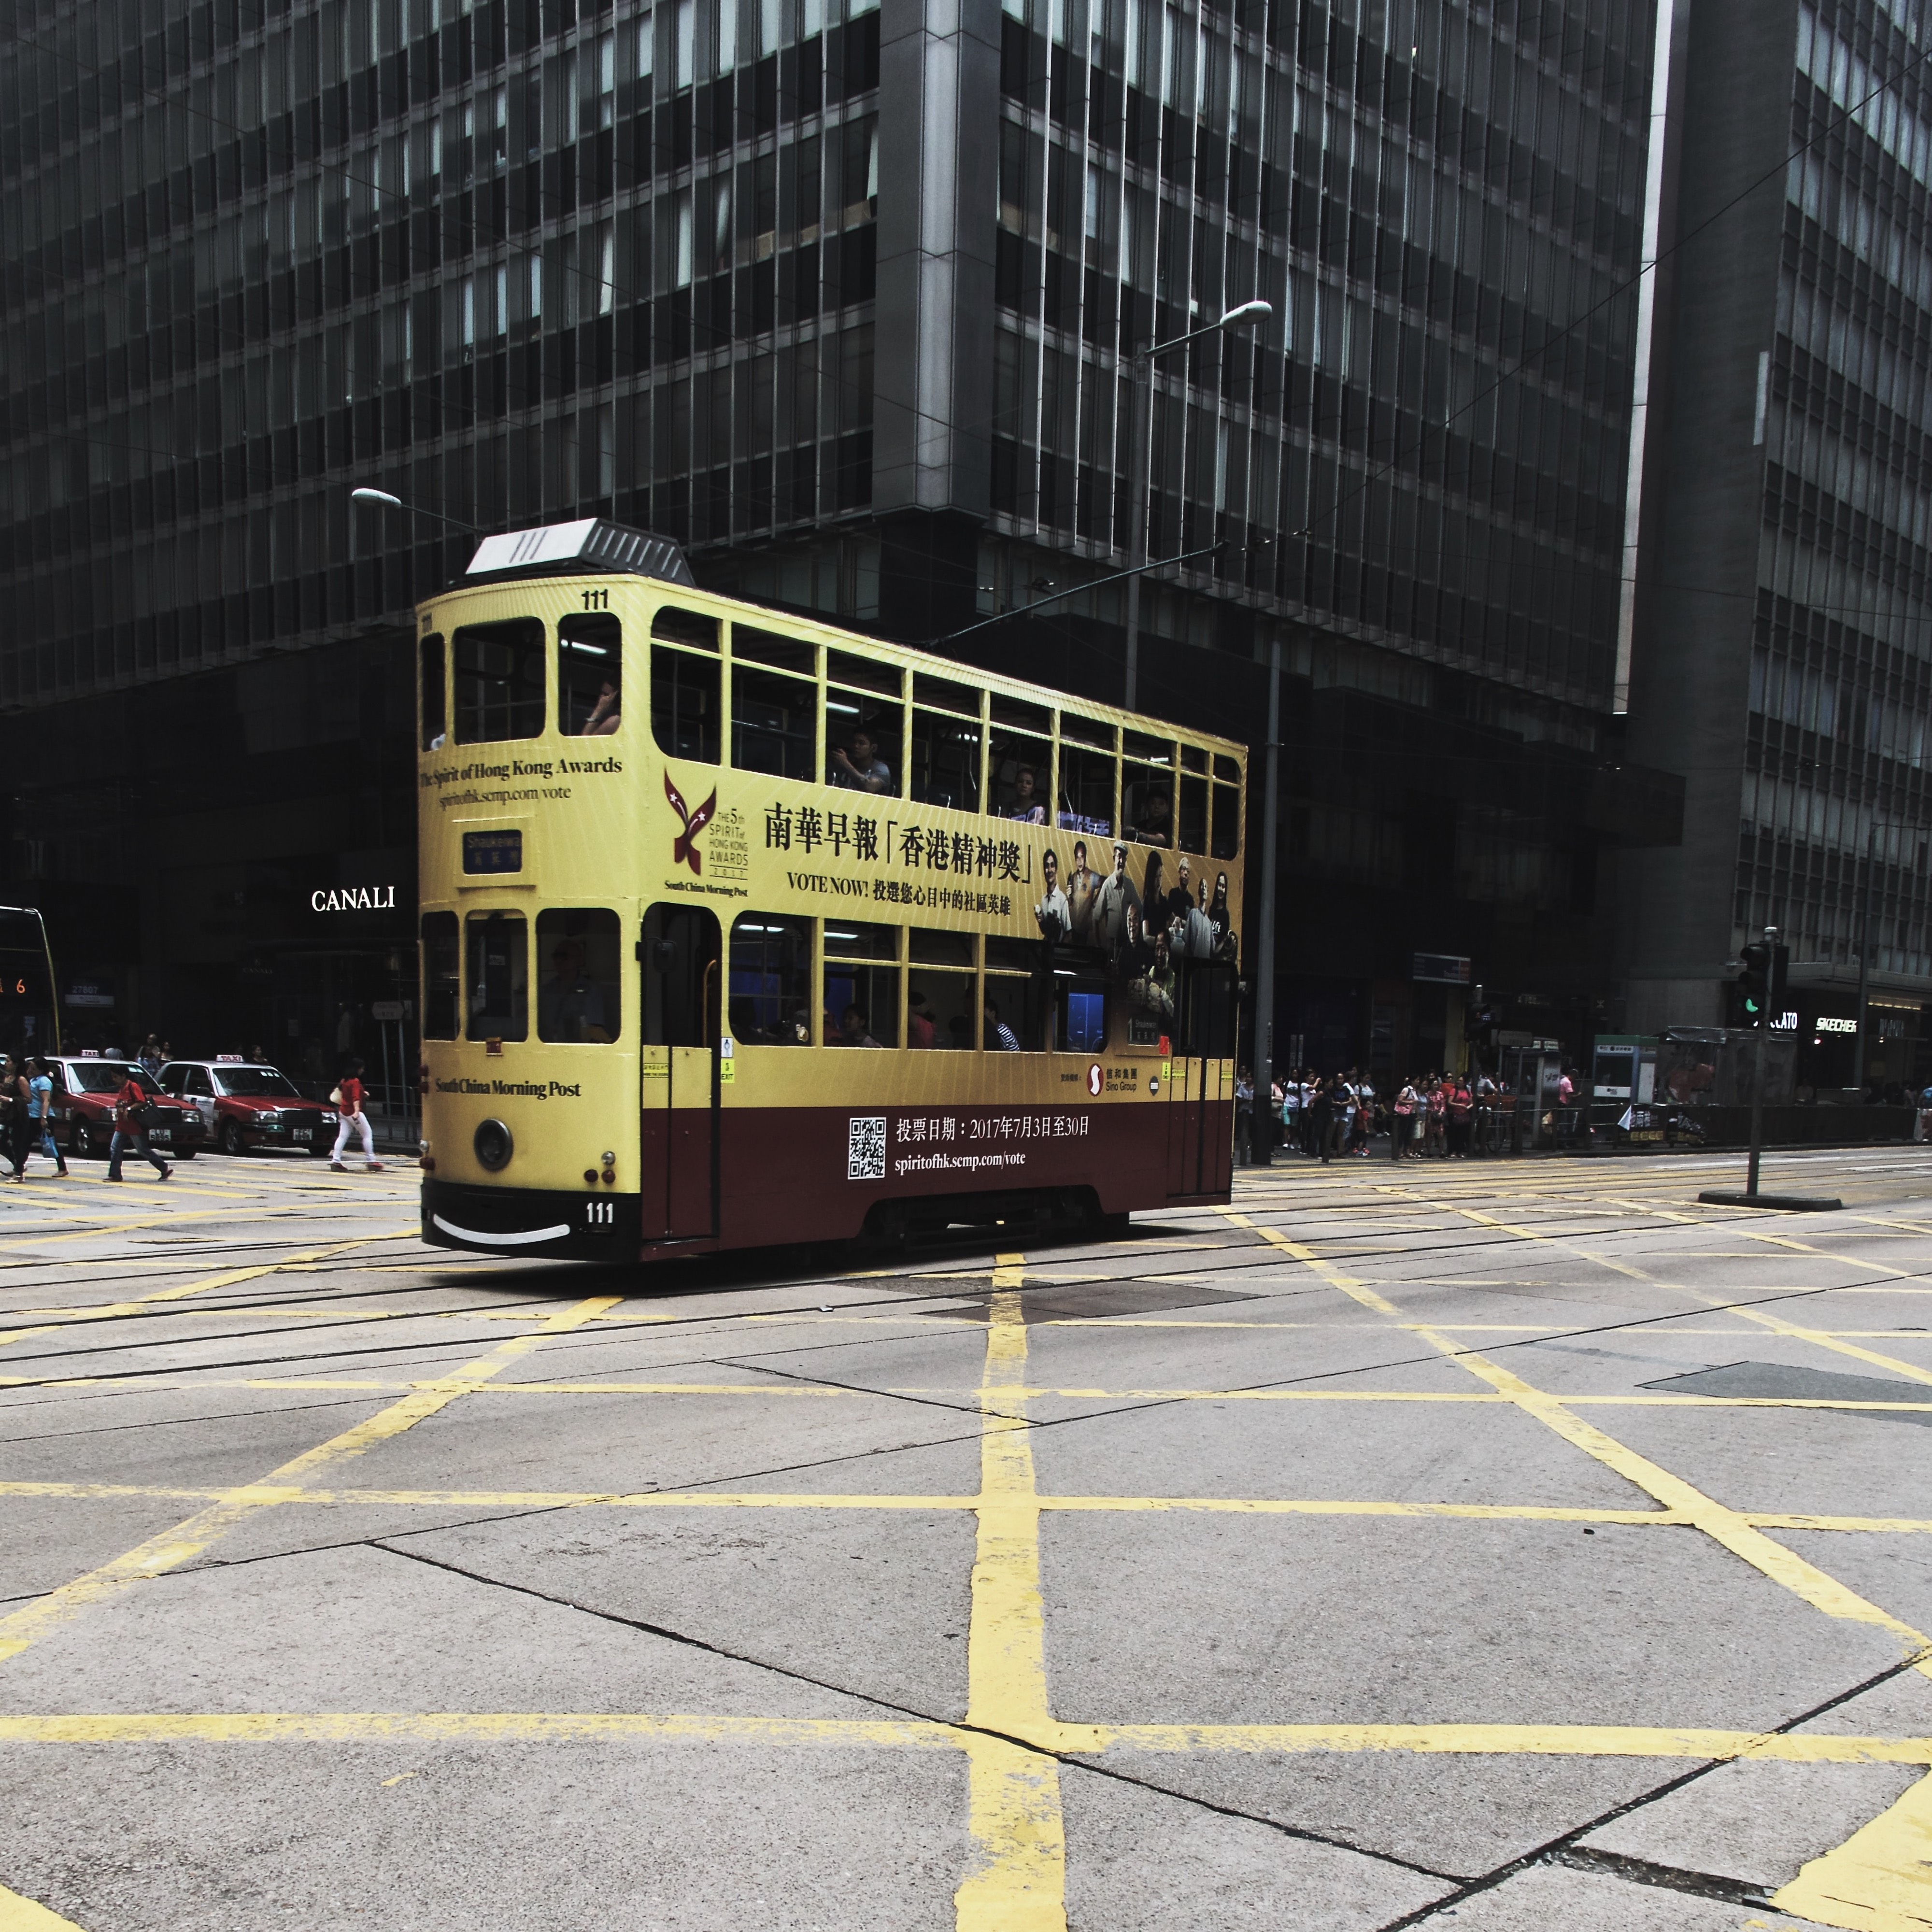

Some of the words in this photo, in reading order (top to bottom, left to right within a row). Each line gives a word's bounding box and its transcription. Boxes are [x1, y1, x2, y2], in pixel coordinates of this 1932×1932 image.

[581, 589, 608, 610] 111
[433, 767, 458, 789] Spirit
[460, 764, 474, 781] of
[474, 763, 510, 781] Hong
[512, 760, 554, 779] Kong
[556, 757, 623, 773] Awards
[718, 812, 730, 823] THE
[710, 824, 740, 838] SPIRIT
[709, 838, 729, 850] HONG
[730, 841, 749, 852] KONG
[710, 851, 749, 866] AWARDS
[665, 880, 685, 891] South
[685, 882, 705, 893] China
[706, 884, 734, 898] Morning
[734, 887, 748, 897] Post
[786, 871, 828, 893] VOTE
[830, 876, 868, 897] NOW!
[312, 886, 395, 911] CANALI
[16, 979, 26, 994] 6
[435, 1078, 459, 1093] South
[459, 1078, 491, 1094] China
[492, 1080, 547, 1101] Morning
[549, 1081, 582, 1097] Post
[1106, 1081, 1119, 1092] Sino
[1120, 1081, 1137, 1093] Group
[895, 1151, 1026, 1176] spiritofhk.scmp.com/vote
[587, 1203, 613, 1223] 111
